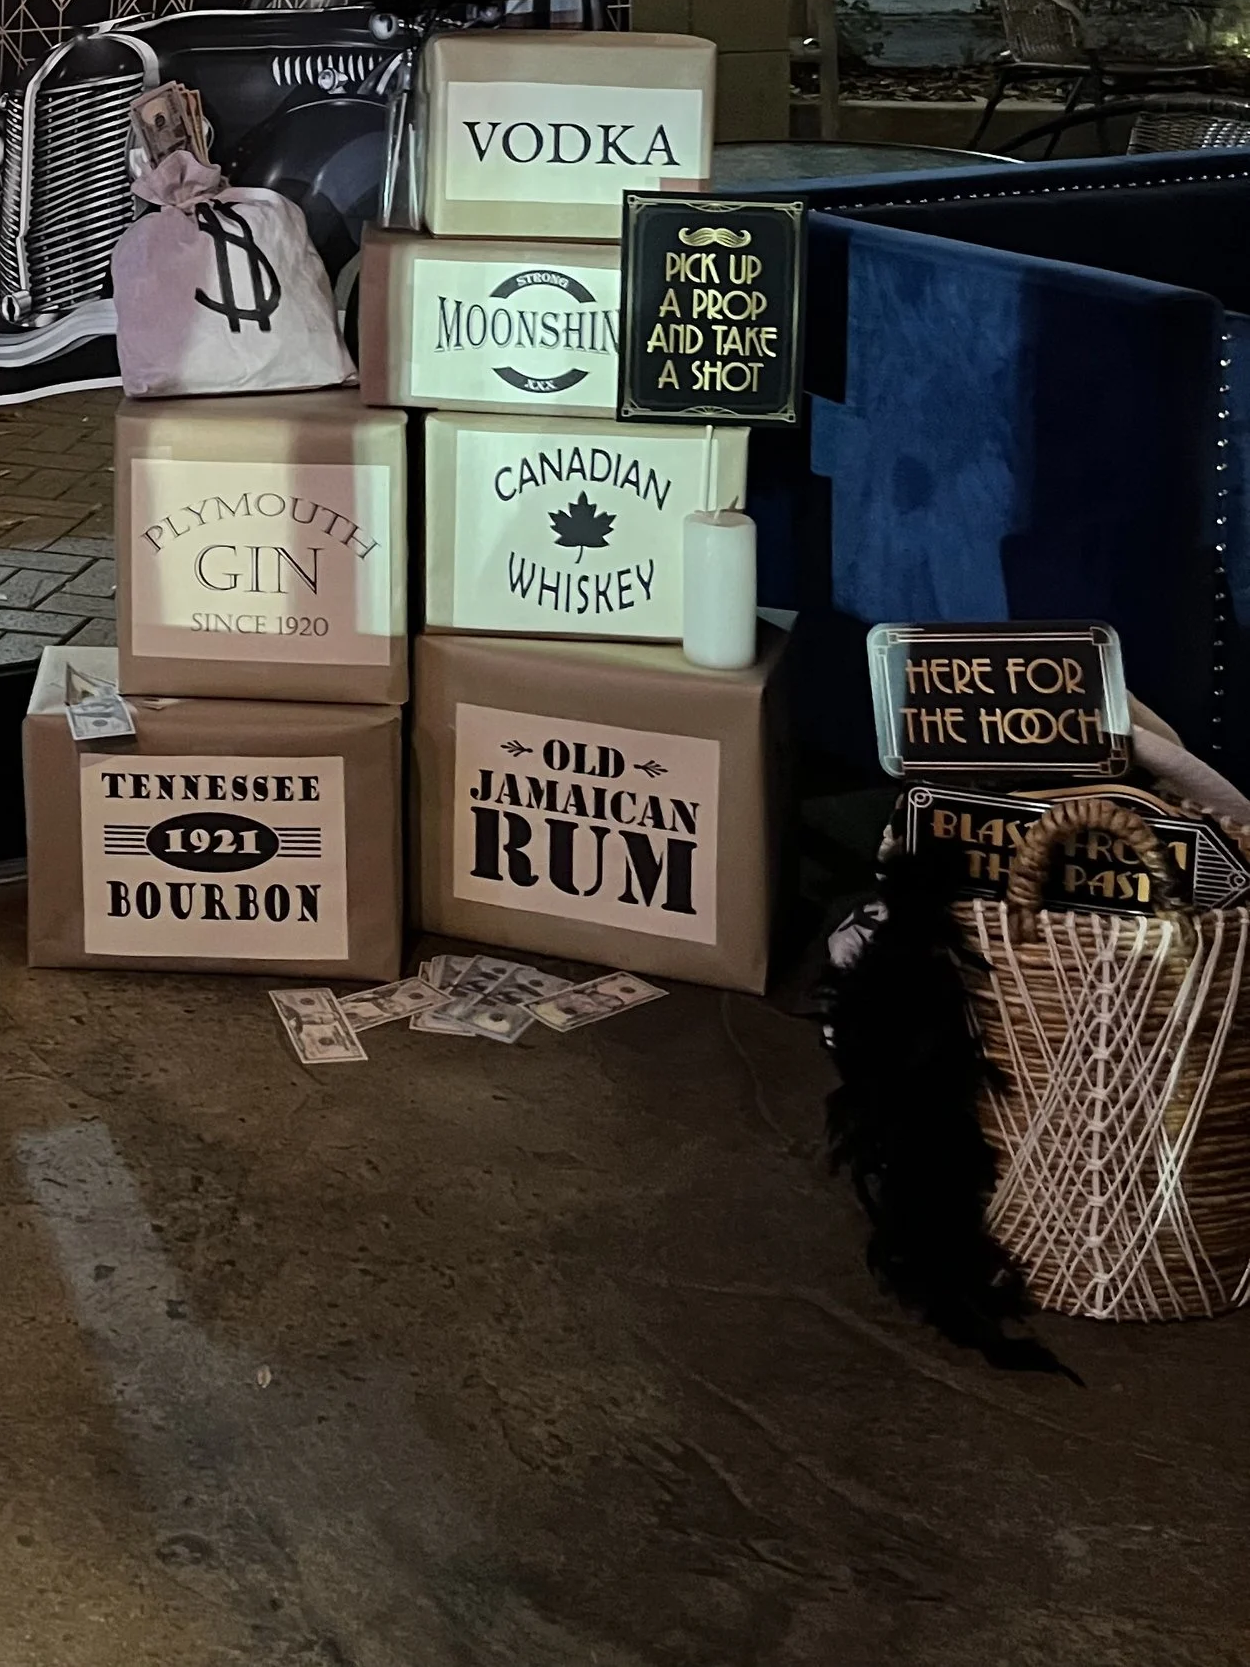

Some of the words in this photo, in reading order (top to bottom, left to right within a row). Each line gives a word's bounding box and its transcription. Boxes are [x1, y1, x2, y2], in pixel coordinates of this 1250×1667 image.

[462, 121, 681, 166] VODKA
[516, 272, 569, 288] STRONG
[665, 252, 720, 284] PICK
[729, 254, 763, 285] UP
[659, 288, 681, 318] A
[692, 288, 768, 320] PROP
[433, 295, 619, 354] MOONSHIN
[647, 323, 704, 354] AND
[711, 325, 778, 358] TAKE
[524, 380, 558, 390] XXX
[657, 359, 680, 390] A
[691, 360, 764, 392] SHOT
[494, 446, 672, 511] CANADIAN
[140, 492, 382, 561] PLYMOUTH
[194, 544, 327, 595] GIN
[509, 551, 655, 614] WHISKEY
[191, 612, 267, 635] SINCE
[278, 616, 329, 637] 1920
[905, 658, 995, 695] HERE
[1005, 658, 1086, 695] FOR
[899, 707, 968, 744] THE
[980, 707, 1105, 745] HOOCH
[543, 739, 625, 778] OLD
[101, 772, 320, 802] TENNESSEE
[470, 769, 700, 835] JAMAICAN
[164, 828, 262, 854] 1921
[470, 806, 698, 915] RUM
[964, 850, 1013, 881] TH
[106, 880, 321, 923] BOURBON
